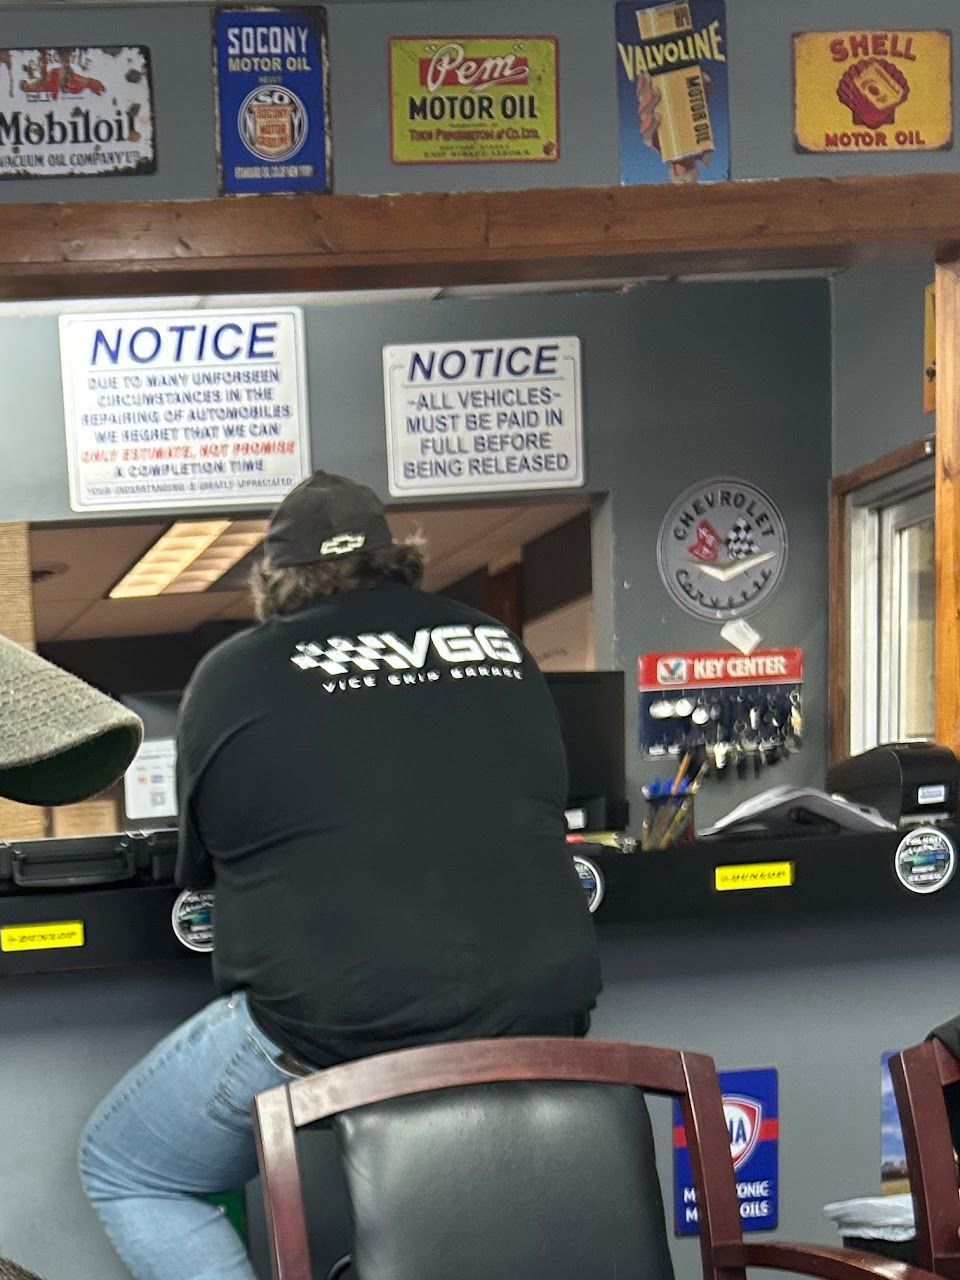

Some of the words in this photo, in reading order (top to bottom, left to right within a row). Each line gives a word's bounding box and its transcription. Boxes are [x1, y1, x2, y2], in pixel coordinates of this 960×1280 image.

[227, 26, 309, 56] SOCONY
[617, 20, 726, 81] VALVOLINE
[830, 33, 917, 62] SHELL
[227, 57, 282, 72] MOTOR
[286, 57, 313, 72] OIL
[408, 96, 495, 121] MOTOR
[500, 94, 538, 119] OIL
[686, 75, 707, 121] MOTOR
[824, 131, 888, 147] MOTOR
[895, 130, 926, 145] OIL
[48, 153, 68, 166] OIL
[90, 321, 278, 366] NOTICE
[408, 344, 560, 382] NOTICE
[88, 376, 119, 390] DUE
[123, 374, 141, 388] TO
[146, 372, 189, 387] MANY
[97, 390, 221, 408] CIRCUMSTANCES
[225, 388, 241, 402] IN
[246, 387, 273, 401] THE
[81, 411, 160, 427] REPAIRING
[164, 410, 184, 424] OF
[187, 404, 291, 422] AUTOMOBILES
[406, 414, 459, 434] MUST
[465, 413, 492, 431] BE
[496, 410, 540, 429] PAID
[545, 409, 563, 426] IN
[95, 431, 118, 443] WE
[121, 427, 180, 442] REGRET
[183, 425, 220, 440] THAT
[223, 424, 247, 438] WE
[249, 422, 281, 437] CAN
[420, 436, 469, 456] FULL
[473, 432, 553, 453] BEFORE
[81, 449, 118, 464] ONLY
[200, 443, 230, 458] NOT
[232, 440, 296, 456] PROMISE
[114, 465, 124, 477] A
[128, 461, 226, 477] COMPLETION
[229, 459, 265, 473] TIME
[403, 460, 464, 480] BEING
[468, 453, 570, 476] RELEASED
[88, 486, 111, 496] YOUR
[113, 482, 187, 496] UNDERSTANDING
[673, 490, 775, 541] CHEVROLET
[378, 624, 524, 669] VGG
[693, 658, 723, 679] KEY
[726, 655, 788, 678] CENTER
[321, 675, 377, 693] VICE
